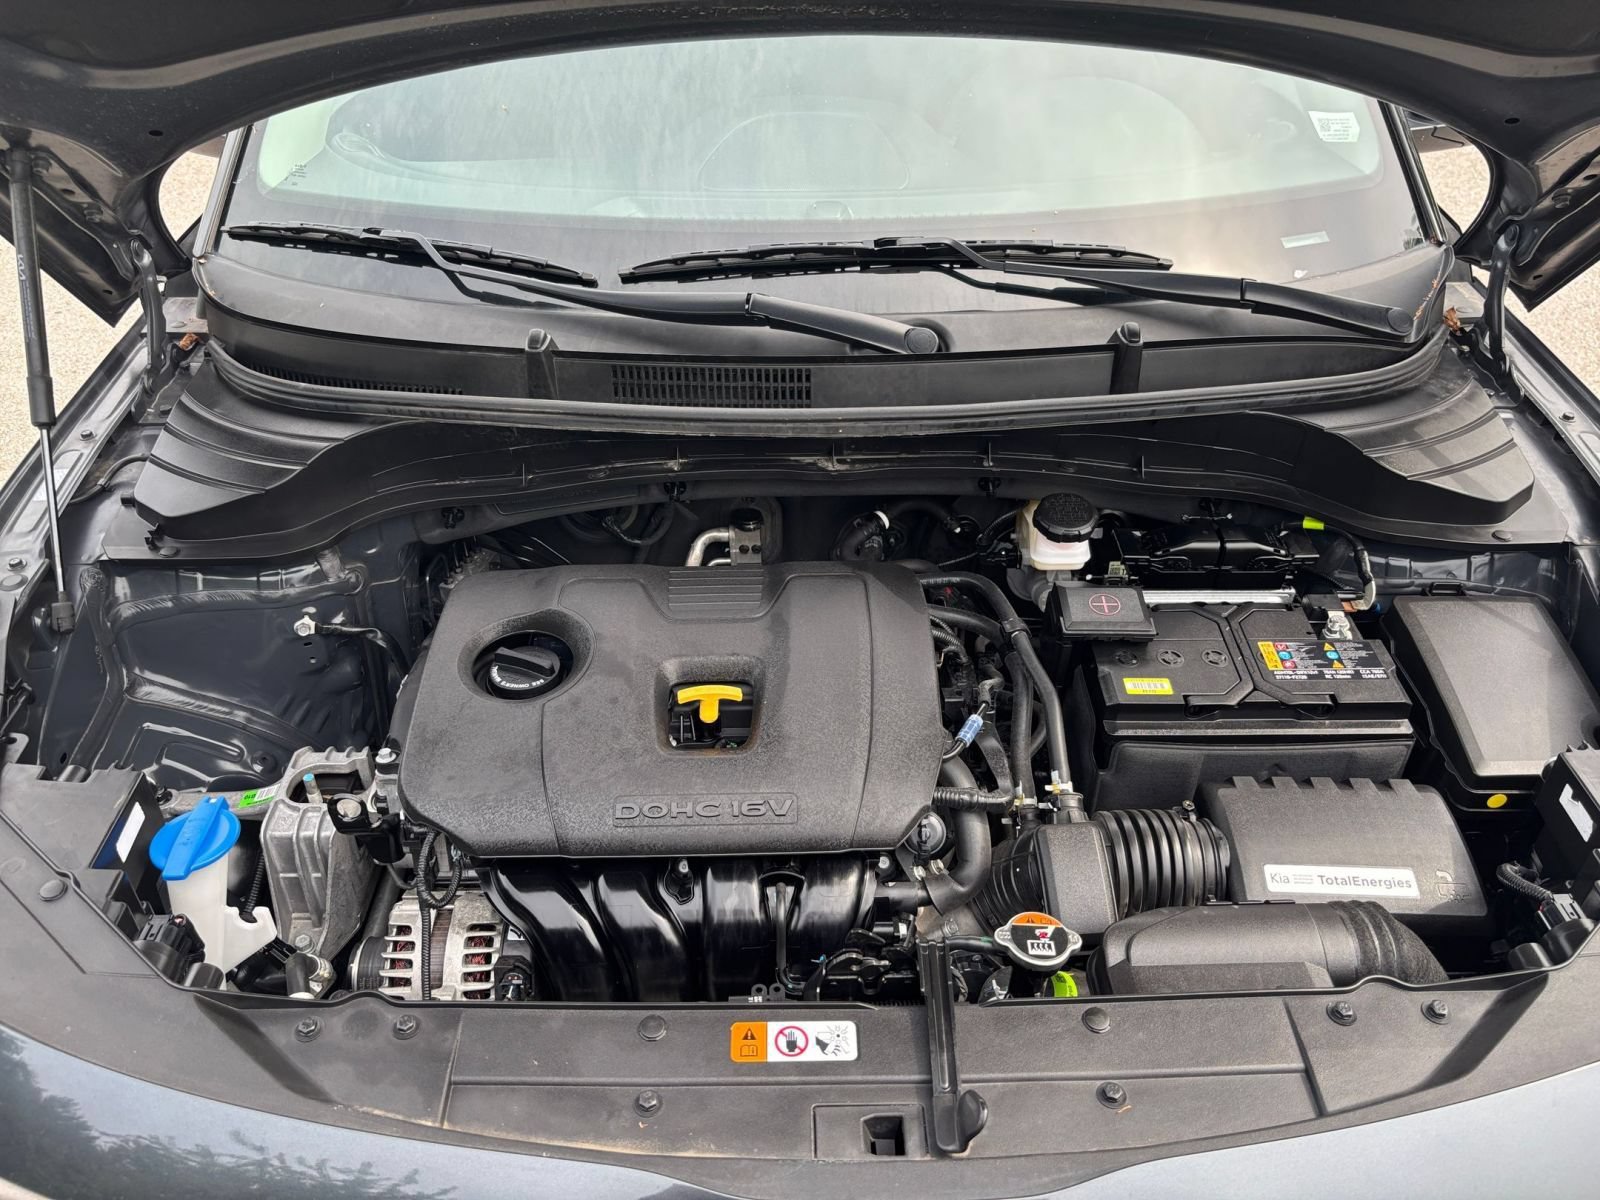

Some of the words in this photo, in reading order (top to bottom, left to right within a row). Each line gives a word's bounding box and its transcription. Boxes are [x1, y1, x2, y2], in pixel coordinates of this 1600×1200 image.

[615, 800, 721, 820] DOHC
[731, 799, 794, 818] 16V
[1270, 872, 1290, 885] Kia
[1317, 874, 1412, 890] TotalEnergies
